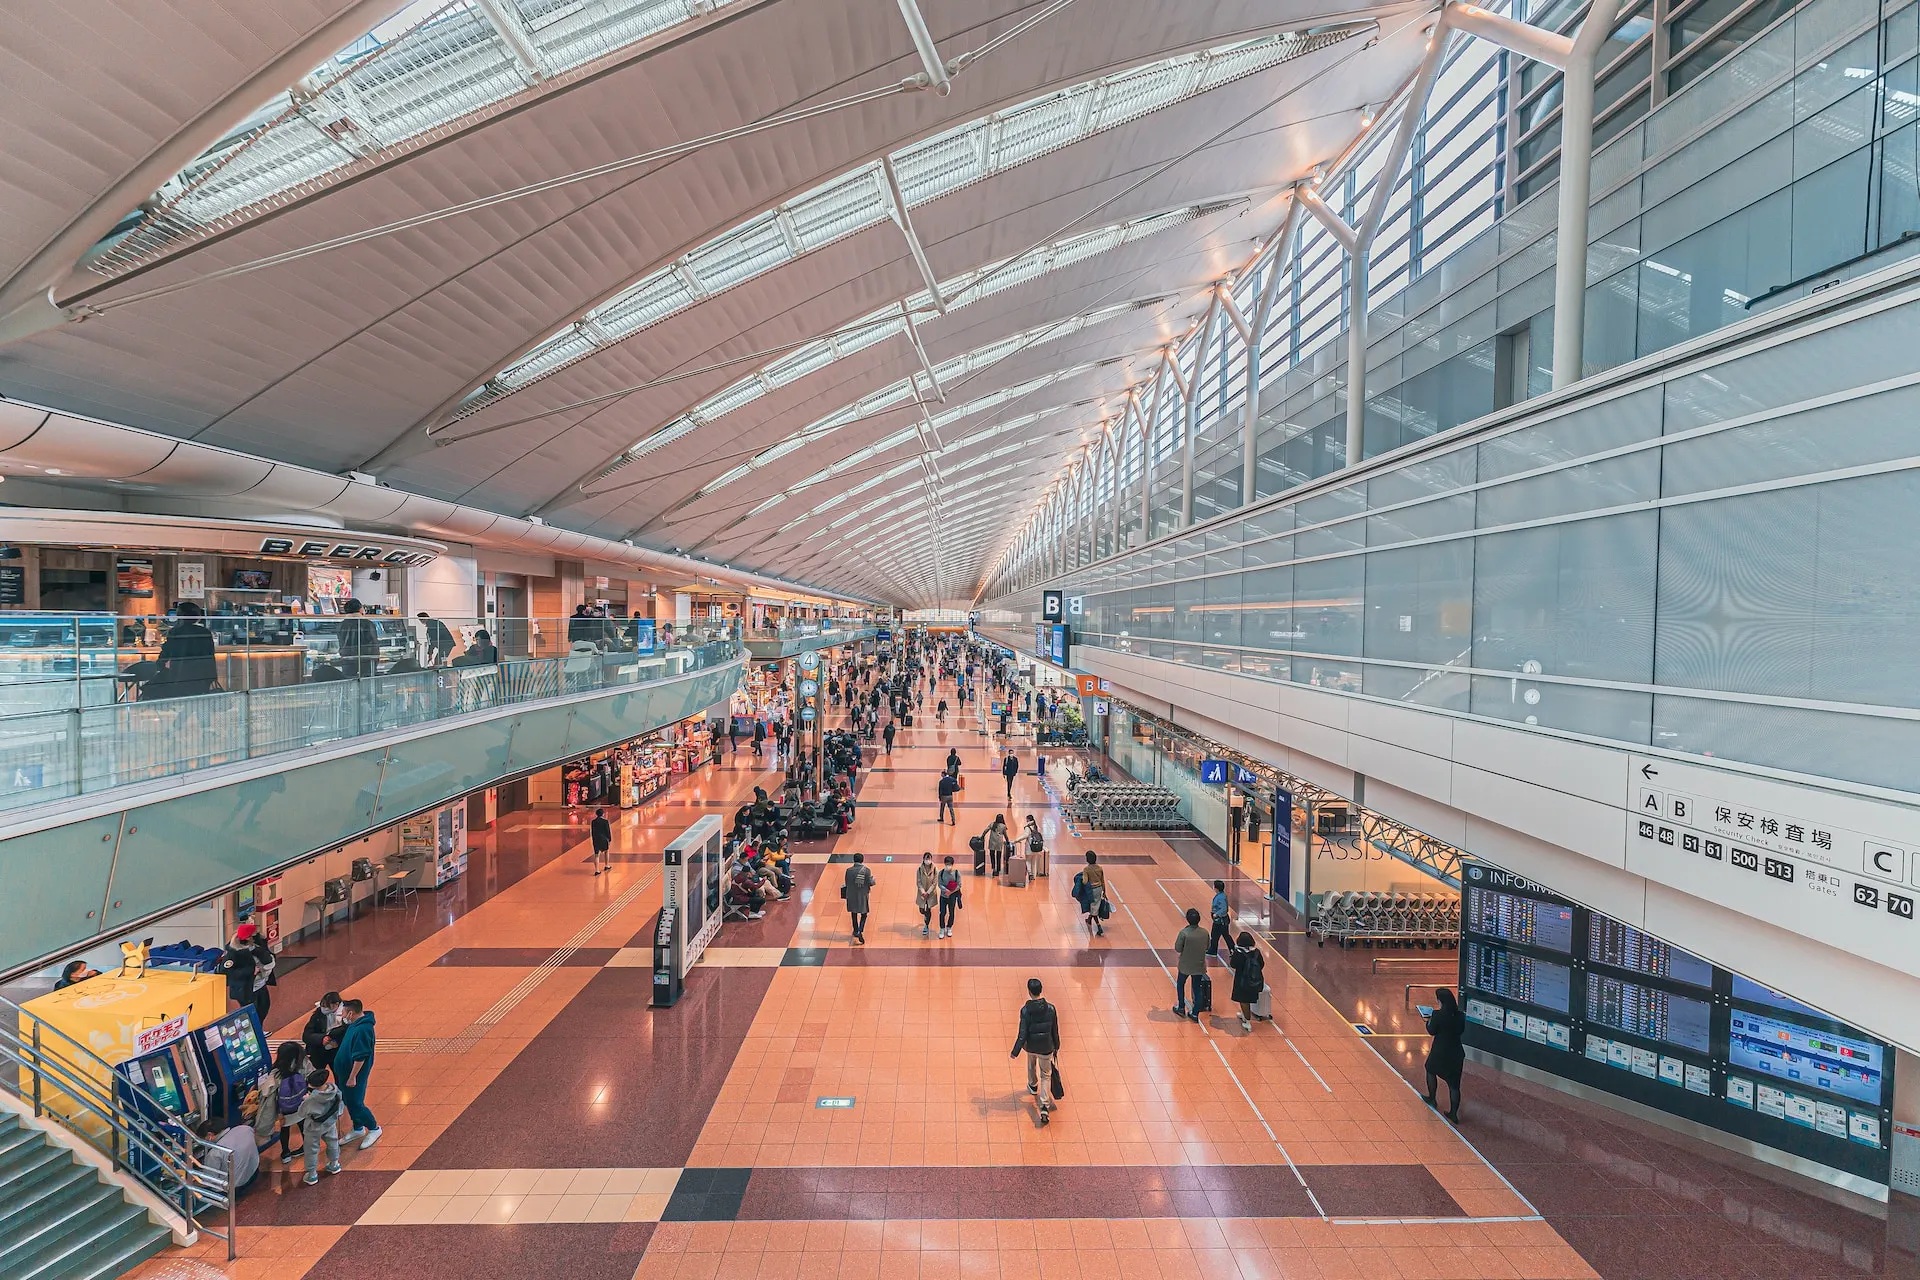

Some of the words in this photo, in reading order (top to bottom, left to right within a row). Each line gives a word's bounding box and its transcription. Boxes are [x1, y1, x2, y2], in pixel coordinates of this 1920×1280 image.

[260, 537, 382, 560] BEER
[1046, 596, 1059, 614] B
[804, 654, 812, 666] 4
[1086, 681, 1094, 691] B
[1645, 795, 1658, 811] A
[1675, 801, 1686, 817] B
[1713, 825, 1744, 840] Security
[1745, 834, 1769, 847] Check
[1714, 805, 1832, 850] 保安検査場
[1640, 824, 1653, 837] 46
[1659, 829, 1673, 842] 48
[1684, 836, 1698, 851] 51
[1706, 842, 1721, 858] 61
[1732, 851, 1756, 868] 500
[1766, 861, 1792, 879] 513
[1873, 851, 1892, 873] C
[1805, 869, 1841, 887] 搭乗口
[1808, 881, 1837, 897] Gates
[1855, 887, 1876, 905] 62
[1889, 896, 1912, 915] 70
[138, 1018, 183, 1046] ポケモン
